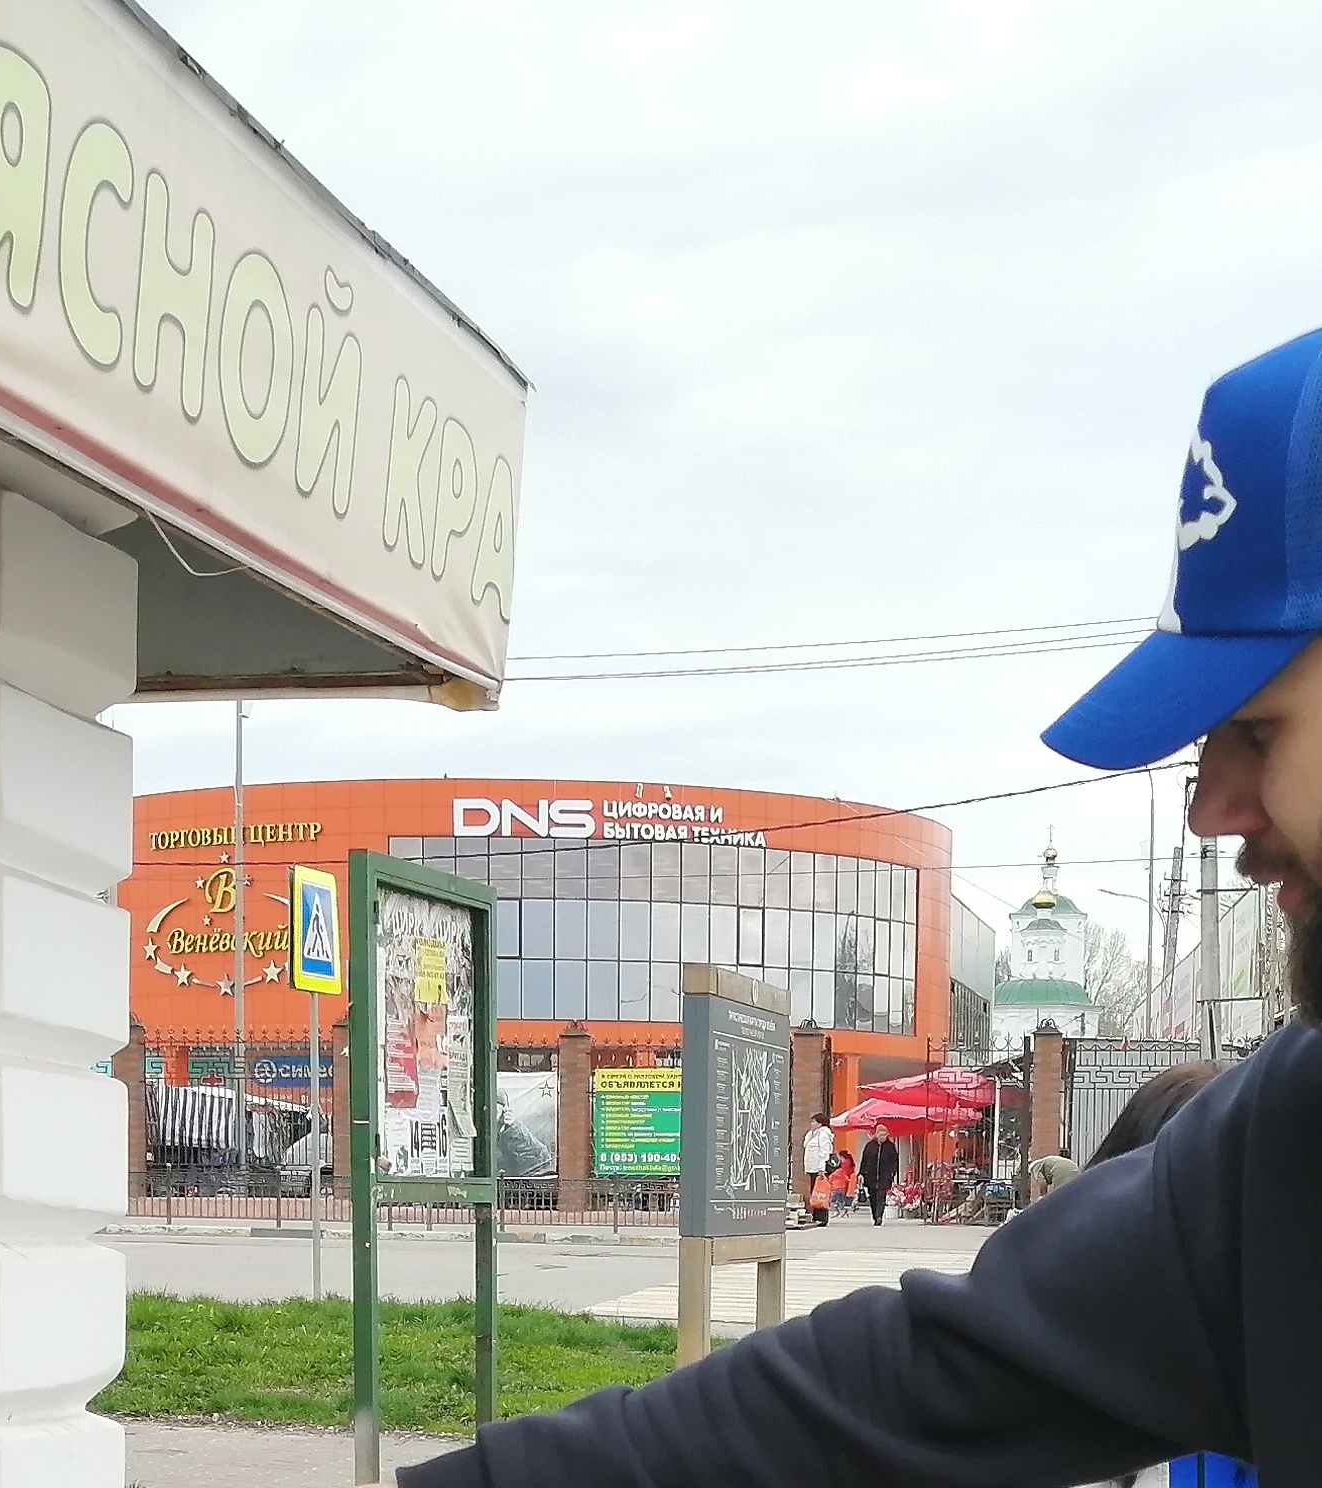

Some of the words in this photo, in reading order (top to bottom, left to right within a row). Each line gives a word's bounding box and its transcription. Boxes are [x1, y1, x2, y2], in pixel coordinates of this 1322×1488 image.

[452, 797, 596, 838] DNS
[603, 799, 705, 823] ЦИФРОВАЯ
[710, 805, 724, 823] И
[250, 822, 323, 847] ЦЕНТР
[603, 822, 688, 842] БЫТОВАЯ
[692, 825, 766, 848] ТЕХНИКА
